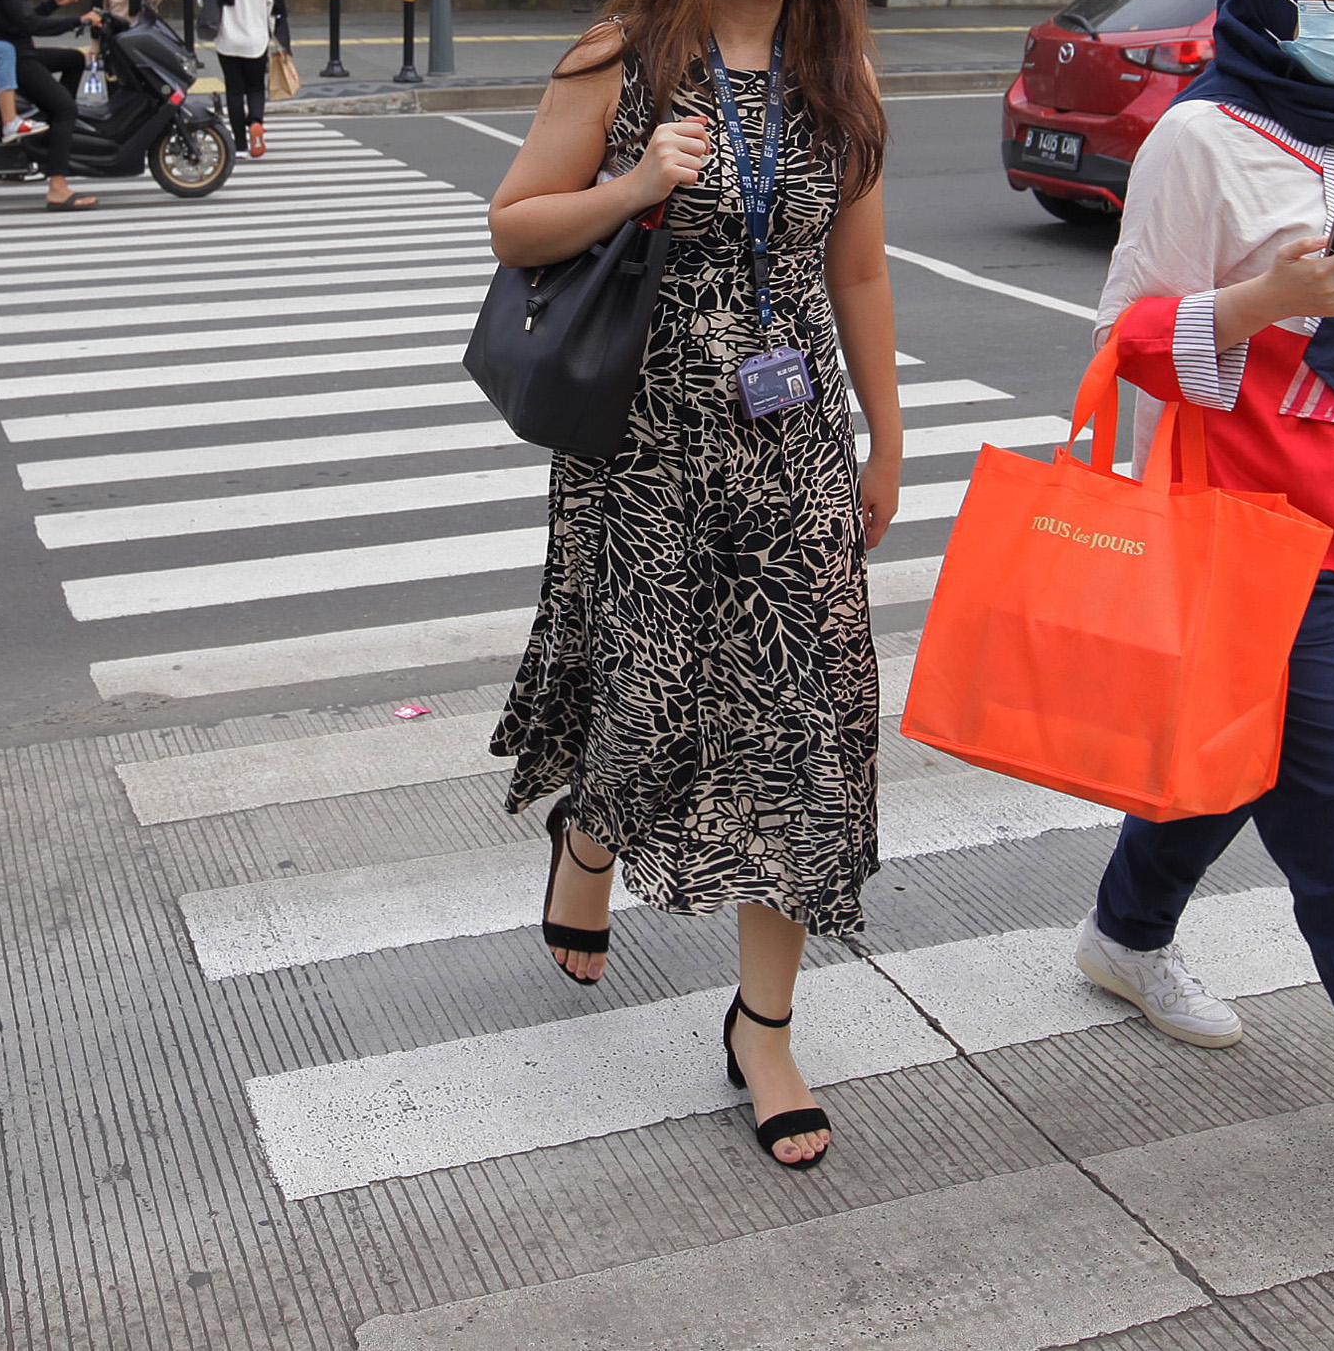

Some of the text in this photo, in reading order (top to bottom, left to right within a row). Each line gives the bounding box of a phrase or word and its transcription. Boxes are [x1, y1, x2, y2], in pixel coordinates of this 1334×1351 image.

[714, 67, 727, 81] EF
[728, 120, 741, 134] EF
[1024, 130, 1034, 148] B
[763, 144, 774, 158] EF
[742, 176, 753, 189] EF
[756, 199, 767, 214] EF
[748, 373, 760, 384] EF
[1031, 515, 1147, 556] TOUS les JOURS
